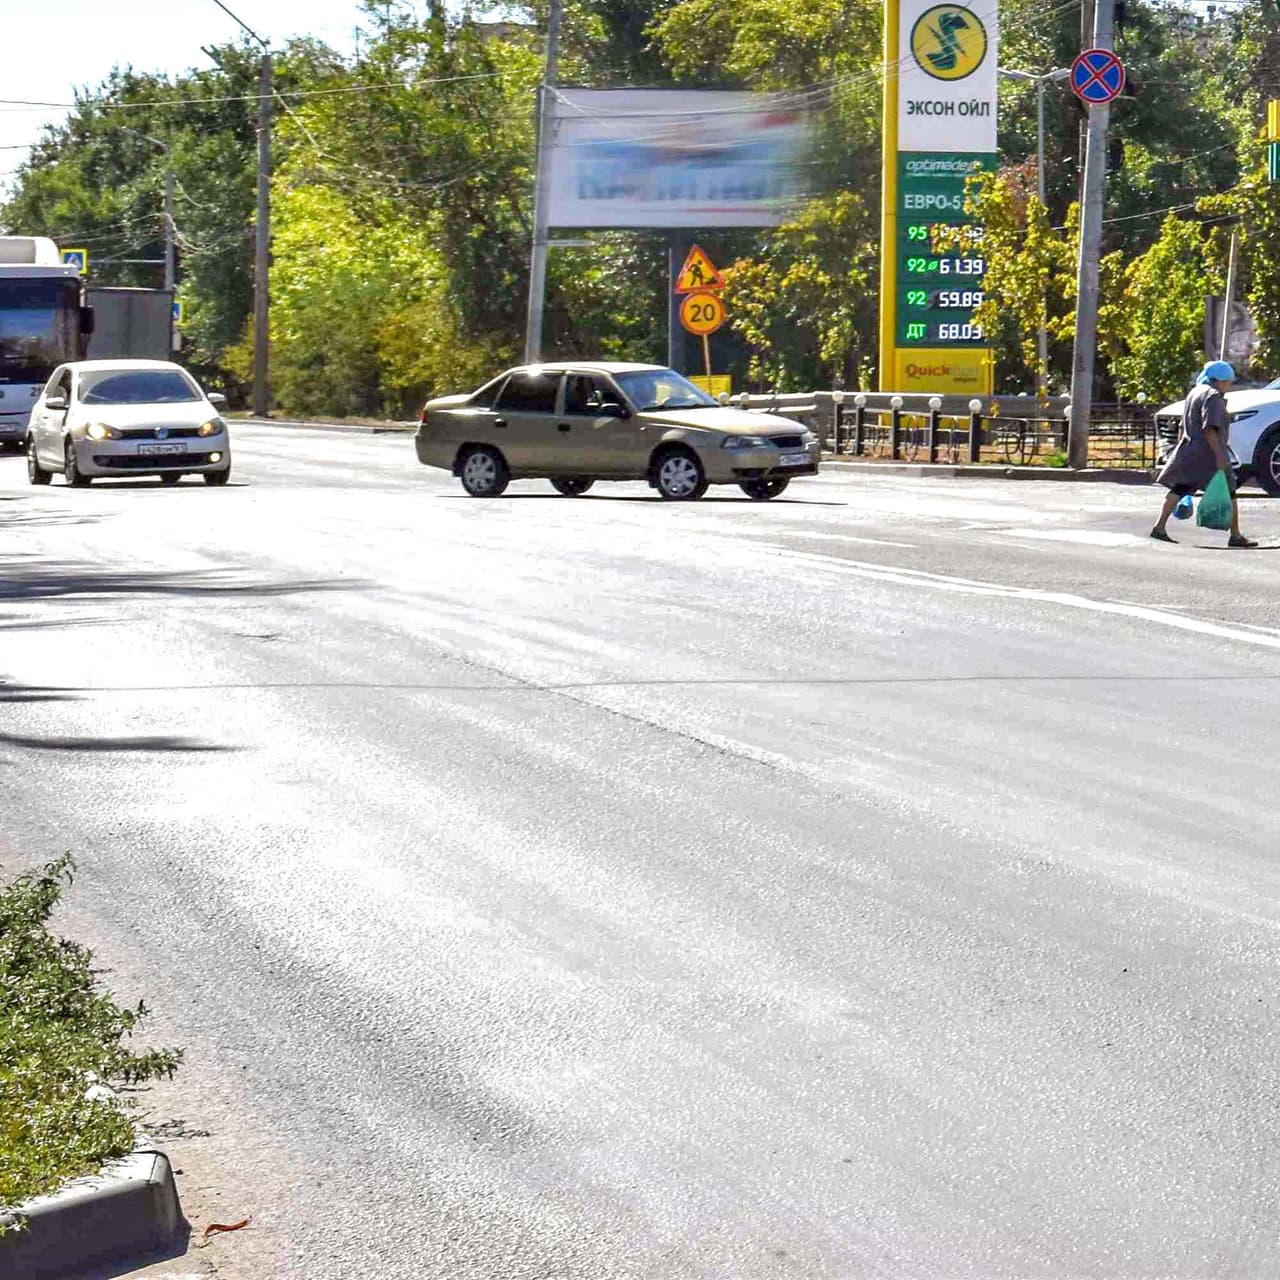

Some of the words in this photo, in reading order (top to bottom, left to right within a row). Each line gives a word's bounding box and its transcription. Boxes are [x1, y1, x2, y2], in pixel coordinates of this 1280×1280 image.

[906, 100, 955, 116] ЭКСОН
[958, 99, 990, 117] ОЙЛ
[903, 194, 962, 210] ЕВРО-5
[908, 226, 928, 240] 95
[907, 258, 926, 272] 92
[907, 291, 926, 305] 92
[938, 291, 984, 308] 59.89
[689, 304, 716, 322] 20
[906, 324, 927, 339] ДТ
